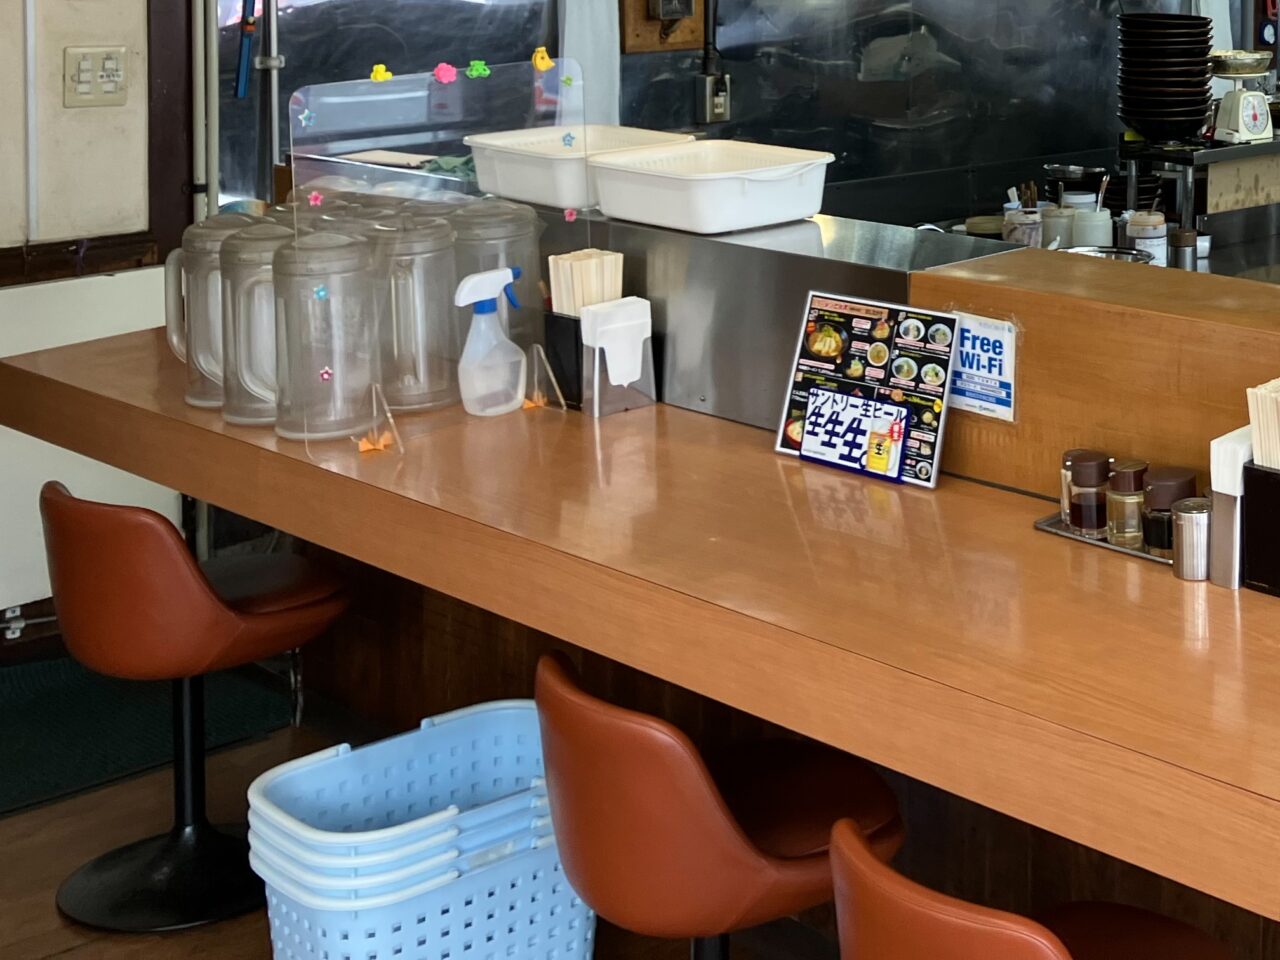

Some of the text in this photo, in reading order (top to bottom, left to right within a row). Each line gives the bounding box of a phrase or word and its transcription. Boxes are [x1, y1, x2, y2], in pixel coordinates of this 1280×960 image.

[959, 327, 1004, 356] Free
[959, 350, 1003, 377] Wi-Fi
[808, 389, 910, 422] サントリー生ビール
